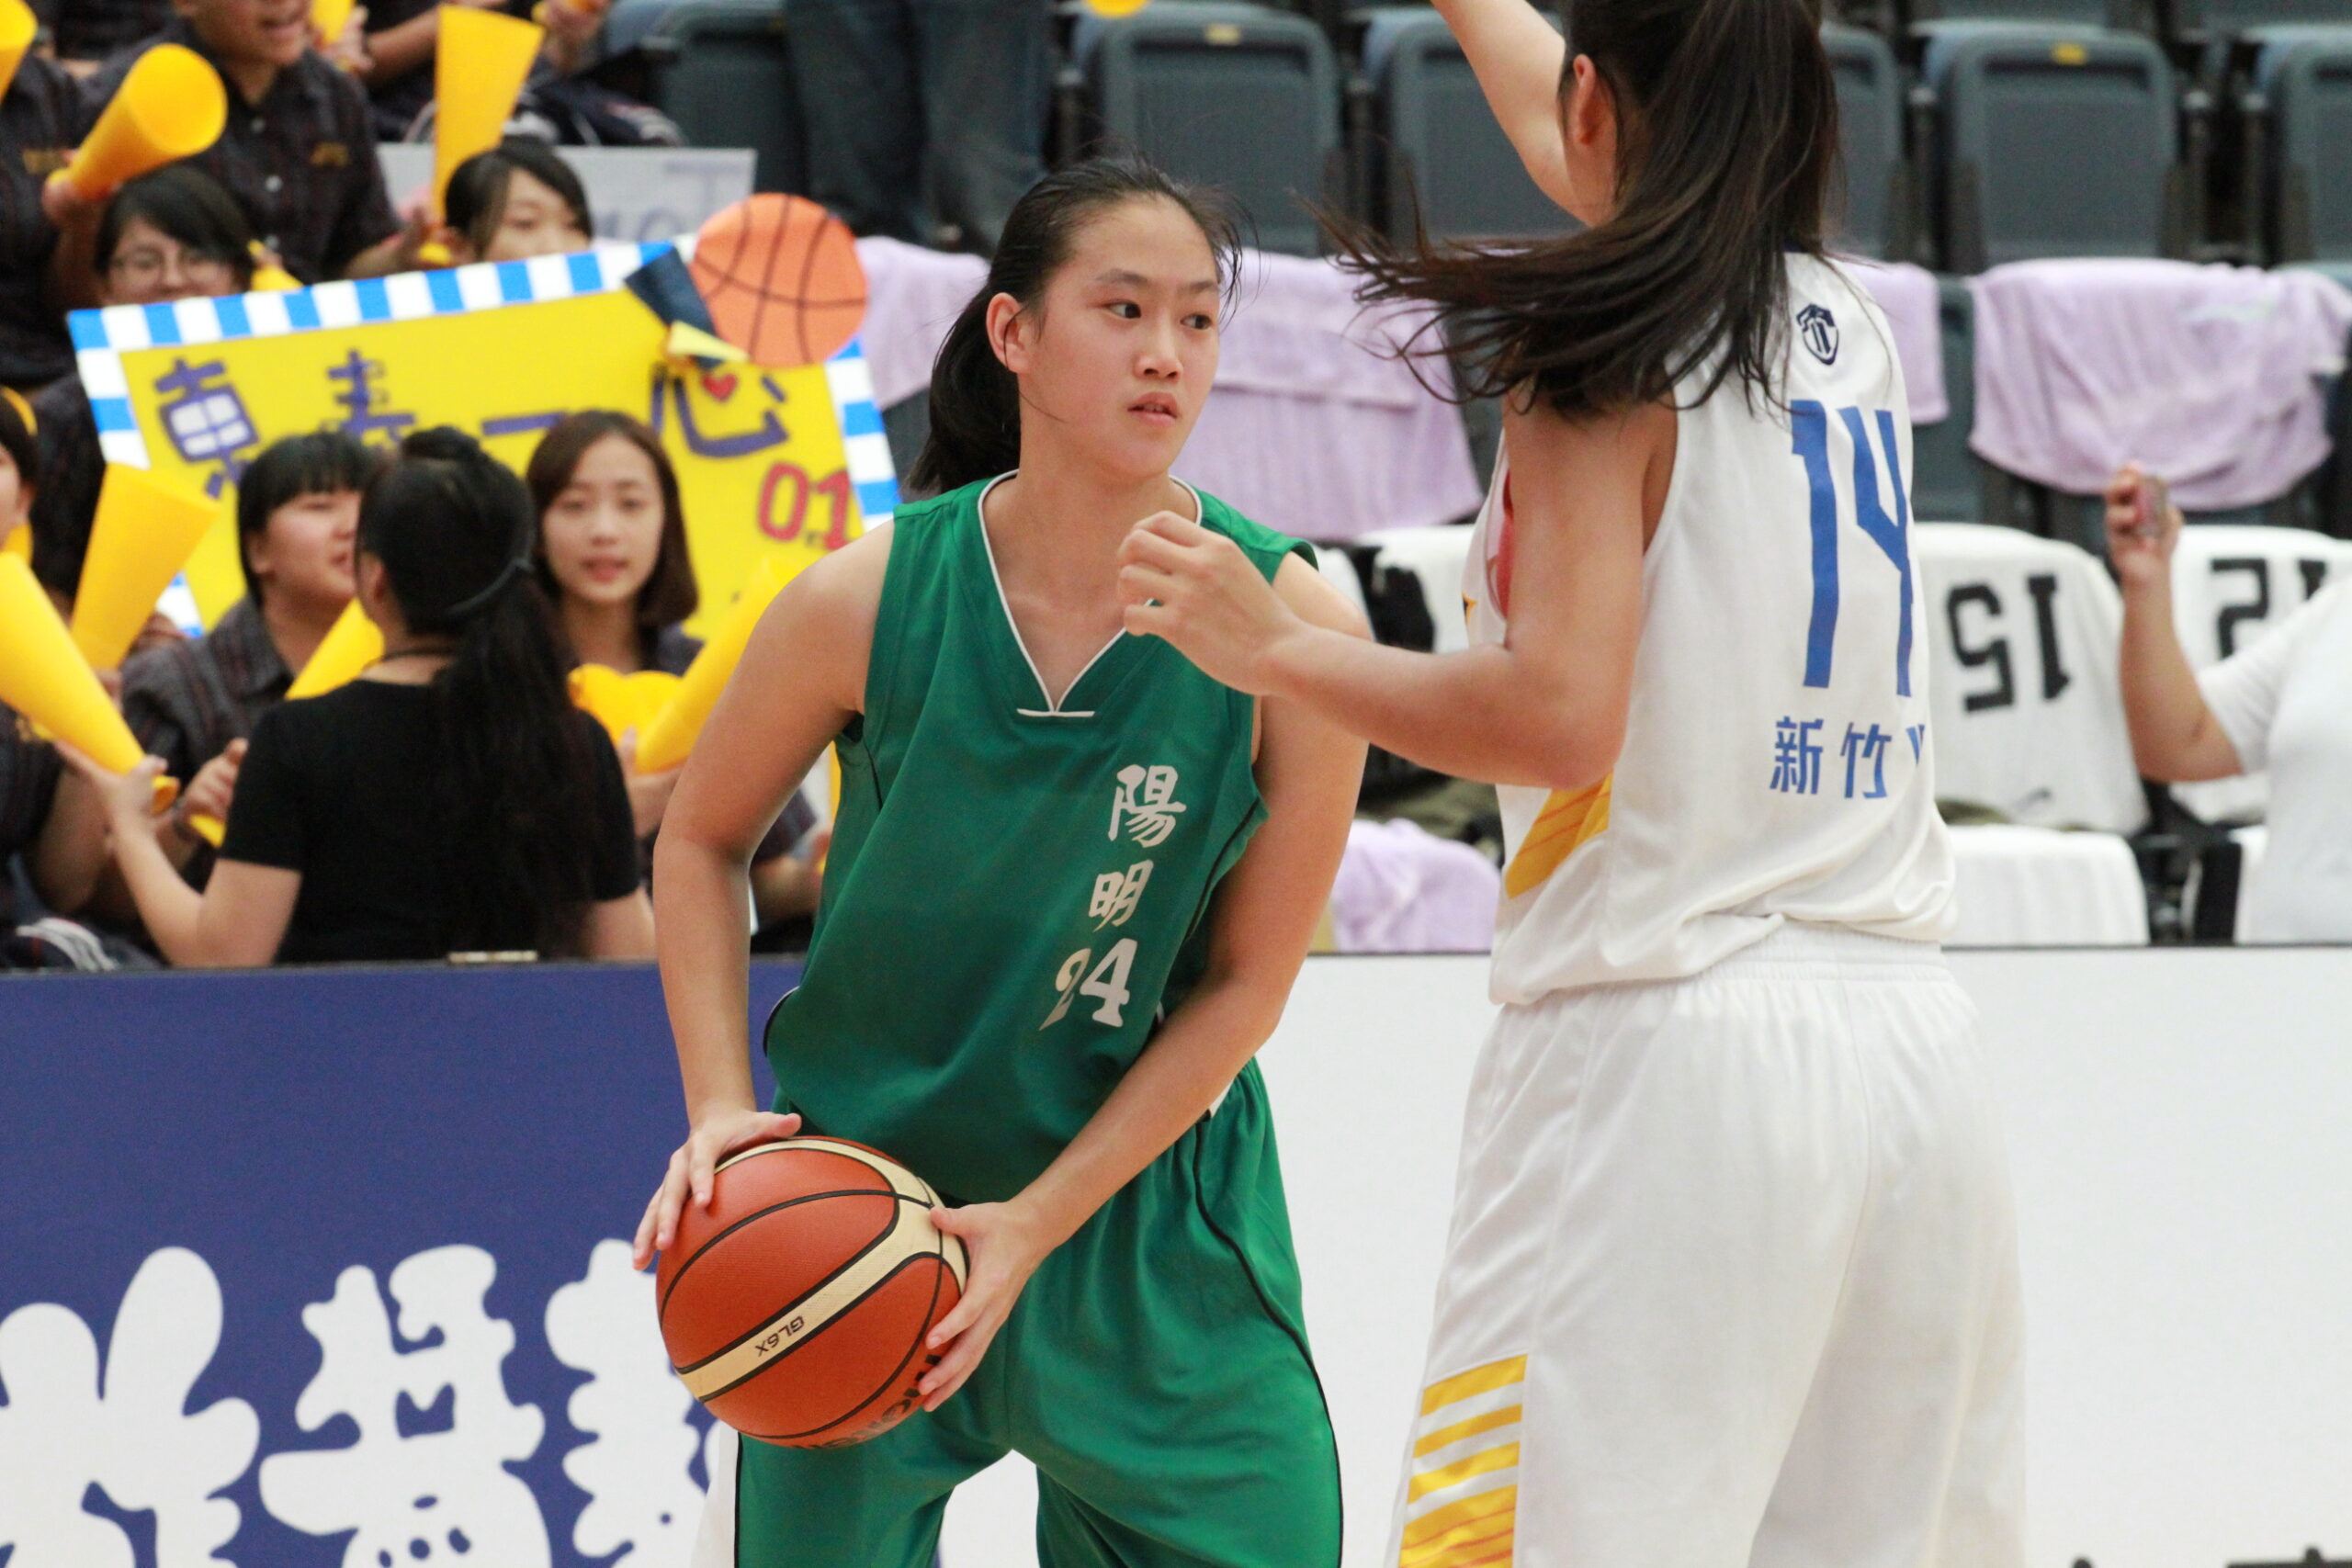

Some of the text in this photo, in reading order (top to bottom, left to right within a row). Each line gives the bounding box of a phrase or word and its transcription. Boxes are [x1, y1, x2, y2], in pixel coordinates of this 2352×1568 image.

[1791, 399, 1913, 697] 14
[1946, 573, 2070, 713] 15
[1770, 716, 1925, 799] 新竹
[1089, 764, 1187, 932] 陽明
[1038, 938, 1138, 1032] 24
[755, 1315, 805, 1357] GL6X
